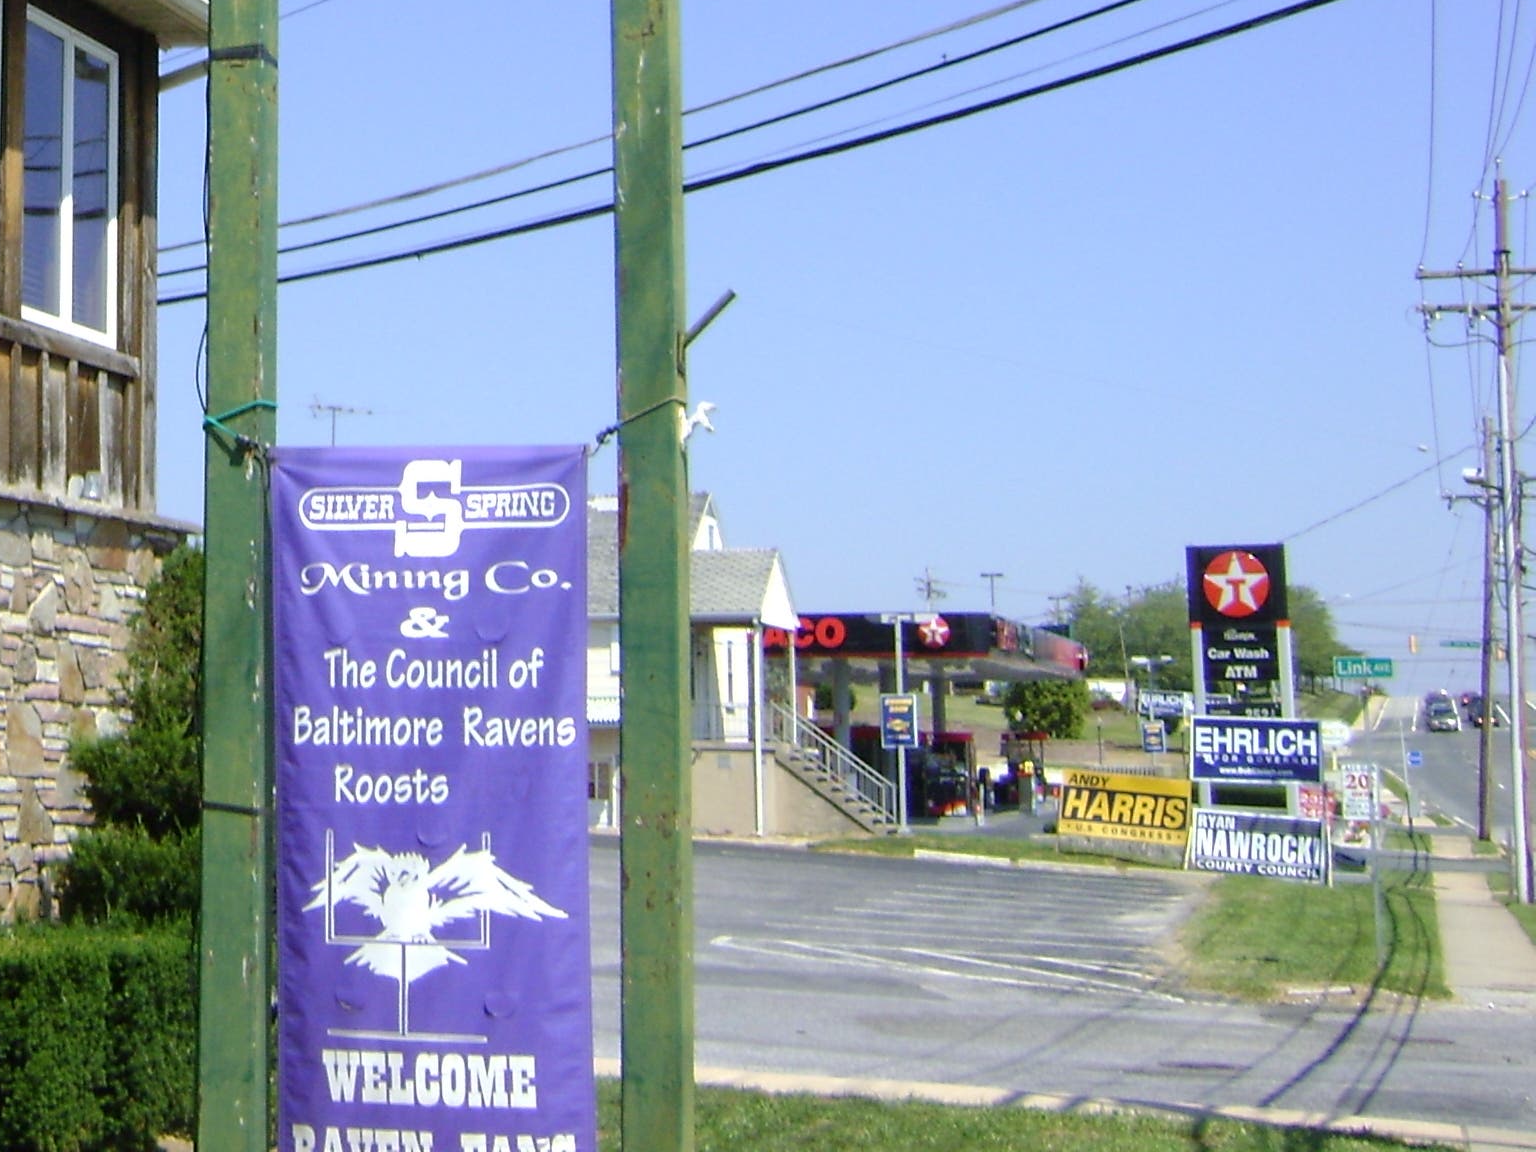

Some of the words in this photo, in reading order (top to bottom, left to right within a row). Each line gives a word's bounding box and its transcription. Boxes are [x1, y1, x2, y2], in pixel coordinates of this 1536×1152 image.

[309, 494, 395, 521] SILVER
[465, 491, 556, 520] SPRING
[300, 562, 470, 600] Mining
[484, 561, 572, 594] Co.
[400, 607, 449, 638] &
[324, 649, 376, 689] The
[385, 649, 498, 689] Council
[509, 647, 545, 689] of
[1207, 647, 1231, 659] Car
[1233, 647, 1270, 659] Wash
[1337, 660, 1373, 675] Link
[1225, 665, 1258, 678] ATM
[293, 705, 444, 746] Baltimore
[463, 706, 576, 747] Ravens
[1195, 726, 1318, 757] EHRLICH
[334, 763, 449, 803] Roosts
[1068, 773, 1110, 786] ANDY
[1064, 788, 1186, 829] HARRIS
[1197, 813, 1236, 830] RYAN
[1196, 829, 1321, 865] NAWROCKI
[1196, 860, 1252, 873] COUNTY
[1257, 864, 1320, 879] COUNCIL
[322, 1049, 537, 1109] WELCOME
